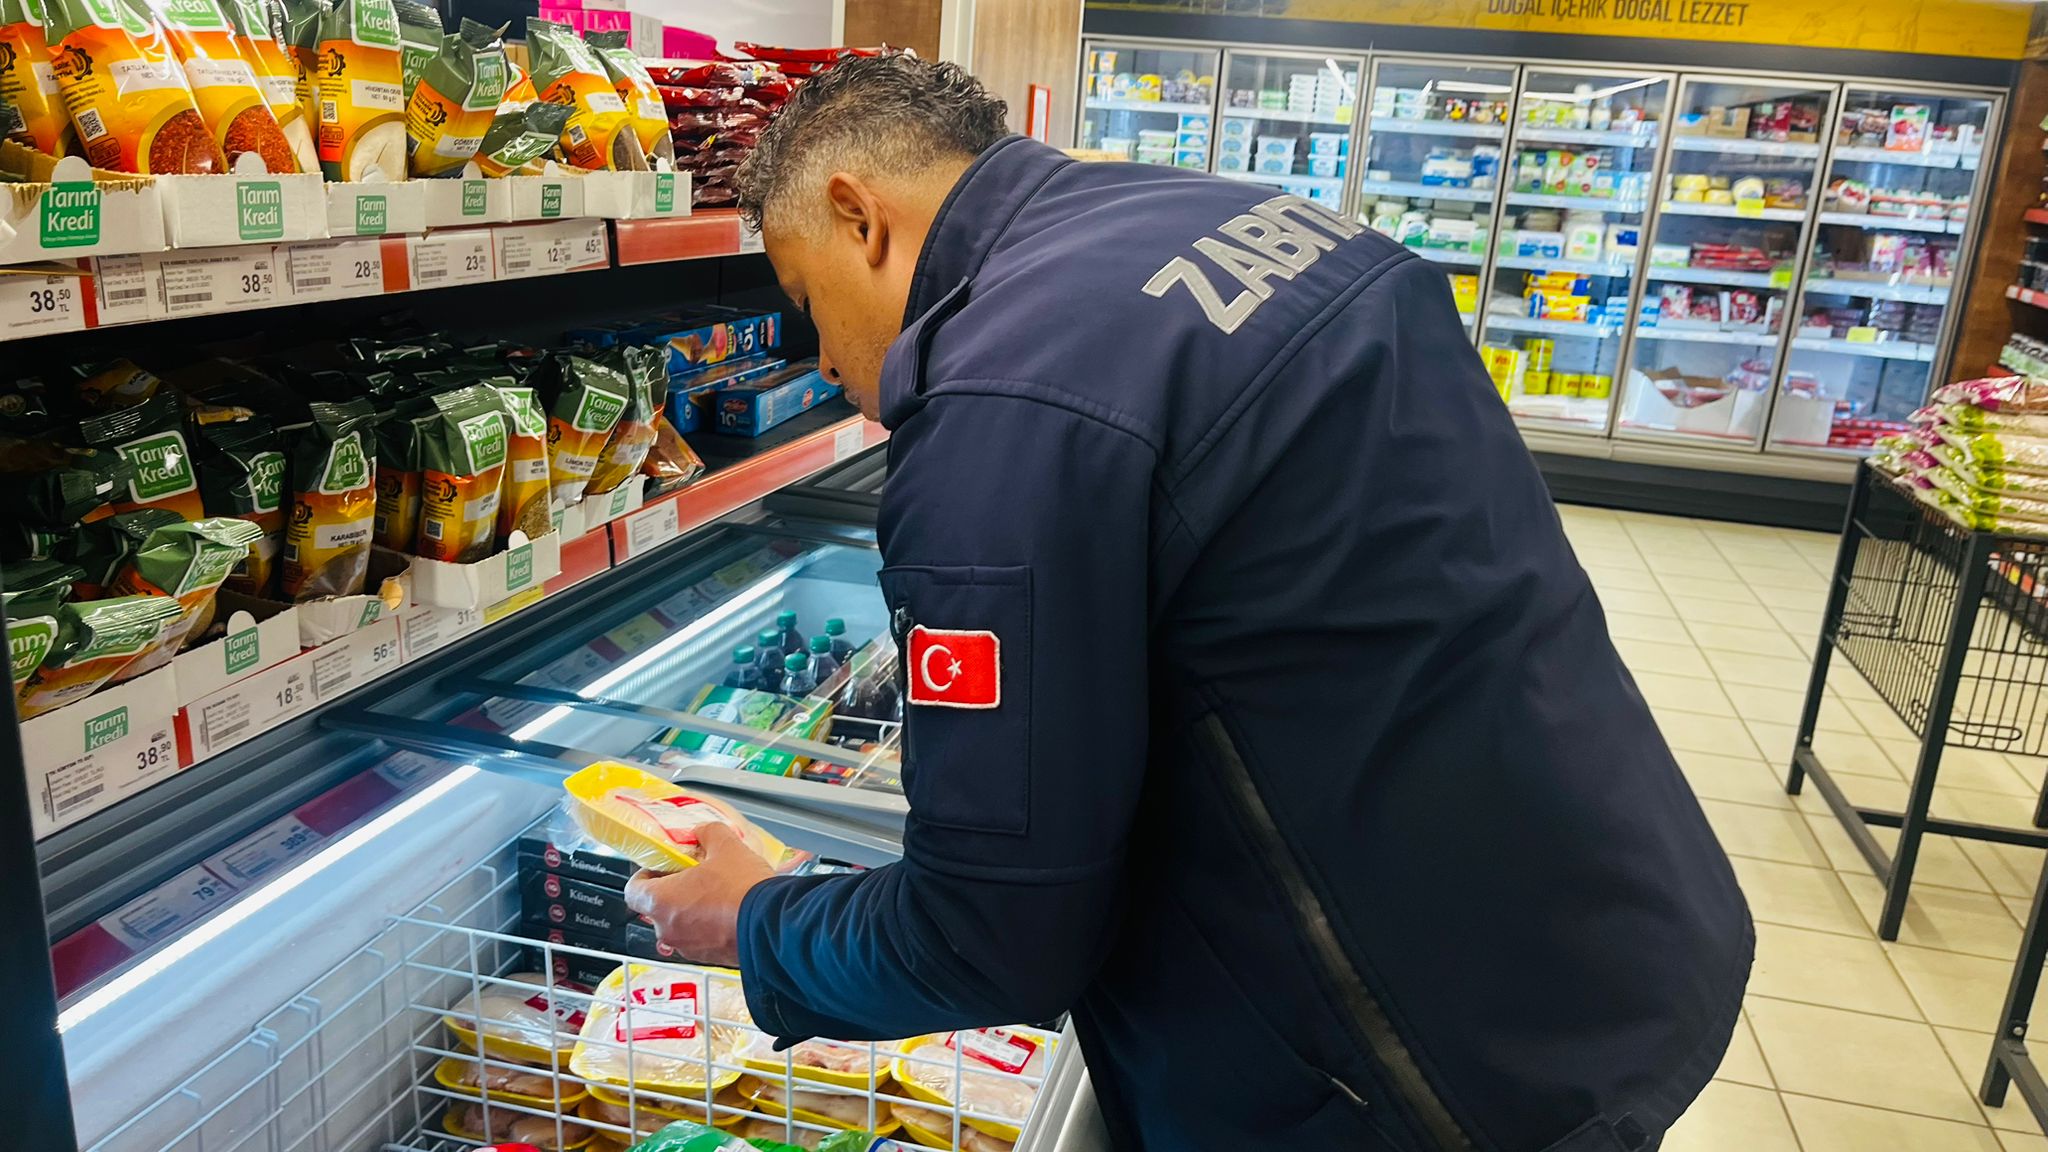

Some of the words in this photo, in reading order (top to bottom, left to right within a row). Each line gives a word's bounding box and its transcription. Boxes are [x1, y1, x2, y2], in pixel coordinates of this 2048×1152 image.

[1678, 1, 1748, 27] LEZZET
[48, 187, 98, 208] Tarım
[239, 185, 280, 204] Tarım
[358, 198, 385, 211] Tarım
[47, 210, 94, 232] Kredi
[243, 206, 278, 226] Kredi
[359, 211, 384, 226] Kredi
[1141, 193, 1366, 336] ZABIT
[60, 303, 70, 312] TL
[588, 391, 621, 413] Tarım
[586, 408, 612, 424] Kredi
[226, 632, 257, 651] Tarım
[229, 642, 256, 665] Kredi
[86, 712, 126, 736] Tarım
[90, 726, 124, 750] Kredi
[569, 888, 604, 906] Künefe
[575, 912, 611, 929] Künefe
